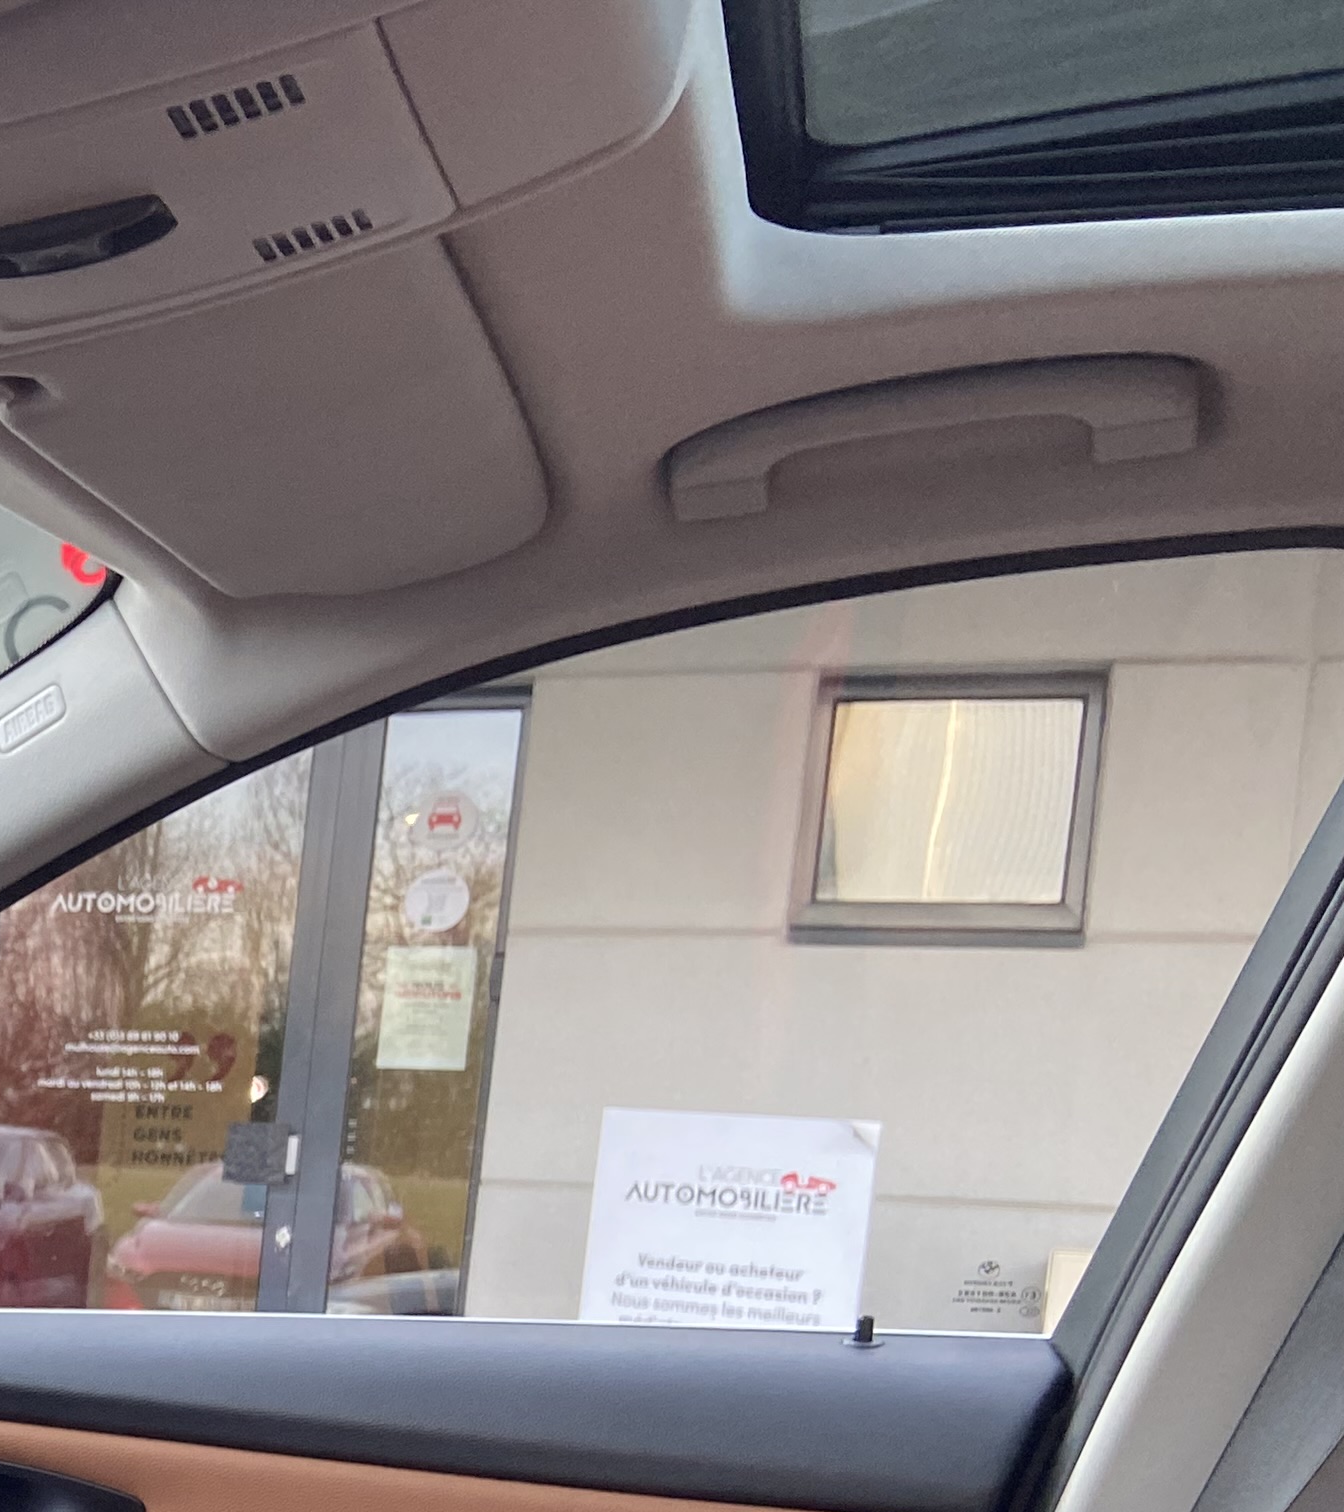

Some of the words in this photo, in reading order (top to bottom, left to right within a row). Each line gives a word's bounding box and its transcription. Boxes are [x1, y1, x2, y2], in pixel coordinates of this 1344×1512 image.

[698, 1164, 781, 1186] L'AGENCE
[638, 1252, 703, 1272] Vendeur
[705, 1261, 725, 1276] ou
[729, 1262, 806, 1282] acheteur
[615, 1271, 649, 1288] d'un
[652, 1273, 716, 1294] véhicule
[721, 1281, 807, 1304] d'occasion
[611, 1291, 649, 1309] Nous
[722, 1301, 743, 1319] les
[747, 1306, 821, 1327] meilleurs
